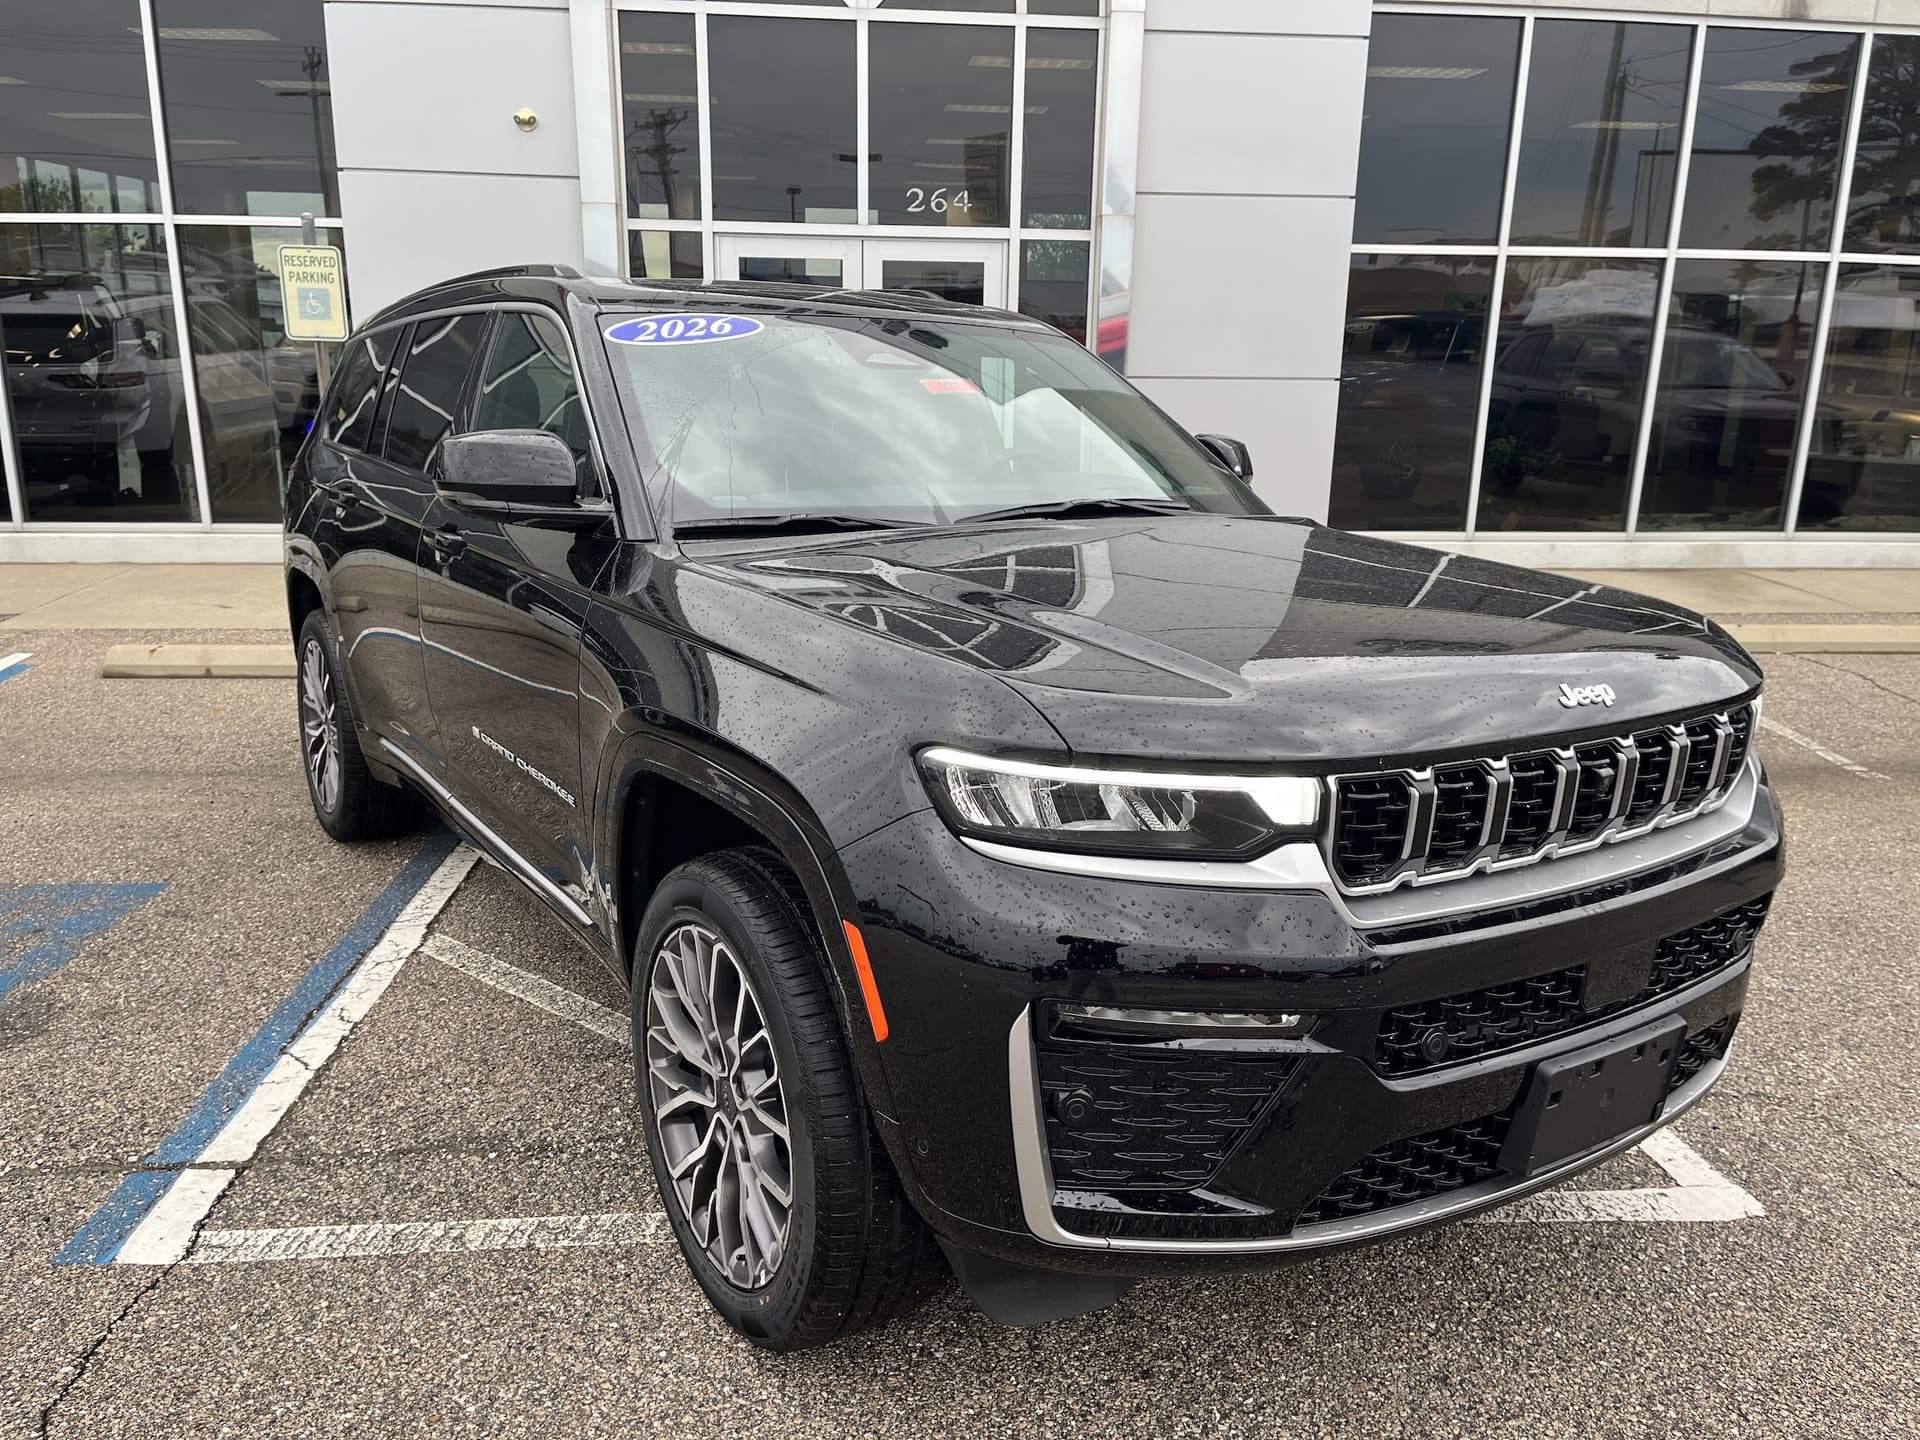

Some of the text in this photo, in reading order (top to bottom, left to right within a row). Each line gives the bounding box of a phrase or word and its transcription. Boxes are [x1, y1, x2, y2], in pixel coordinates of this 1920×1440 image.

[906, 187, 973, 213] 264
[284, 255, 336, 268] RESERVED
[288, 271, 335, 284] PARKING
[633, 316, 734, 341] 2026
[1558, 683, 1616, 708] Jeep
[480, 732, 576, 808] GRAND CHEROKEE
